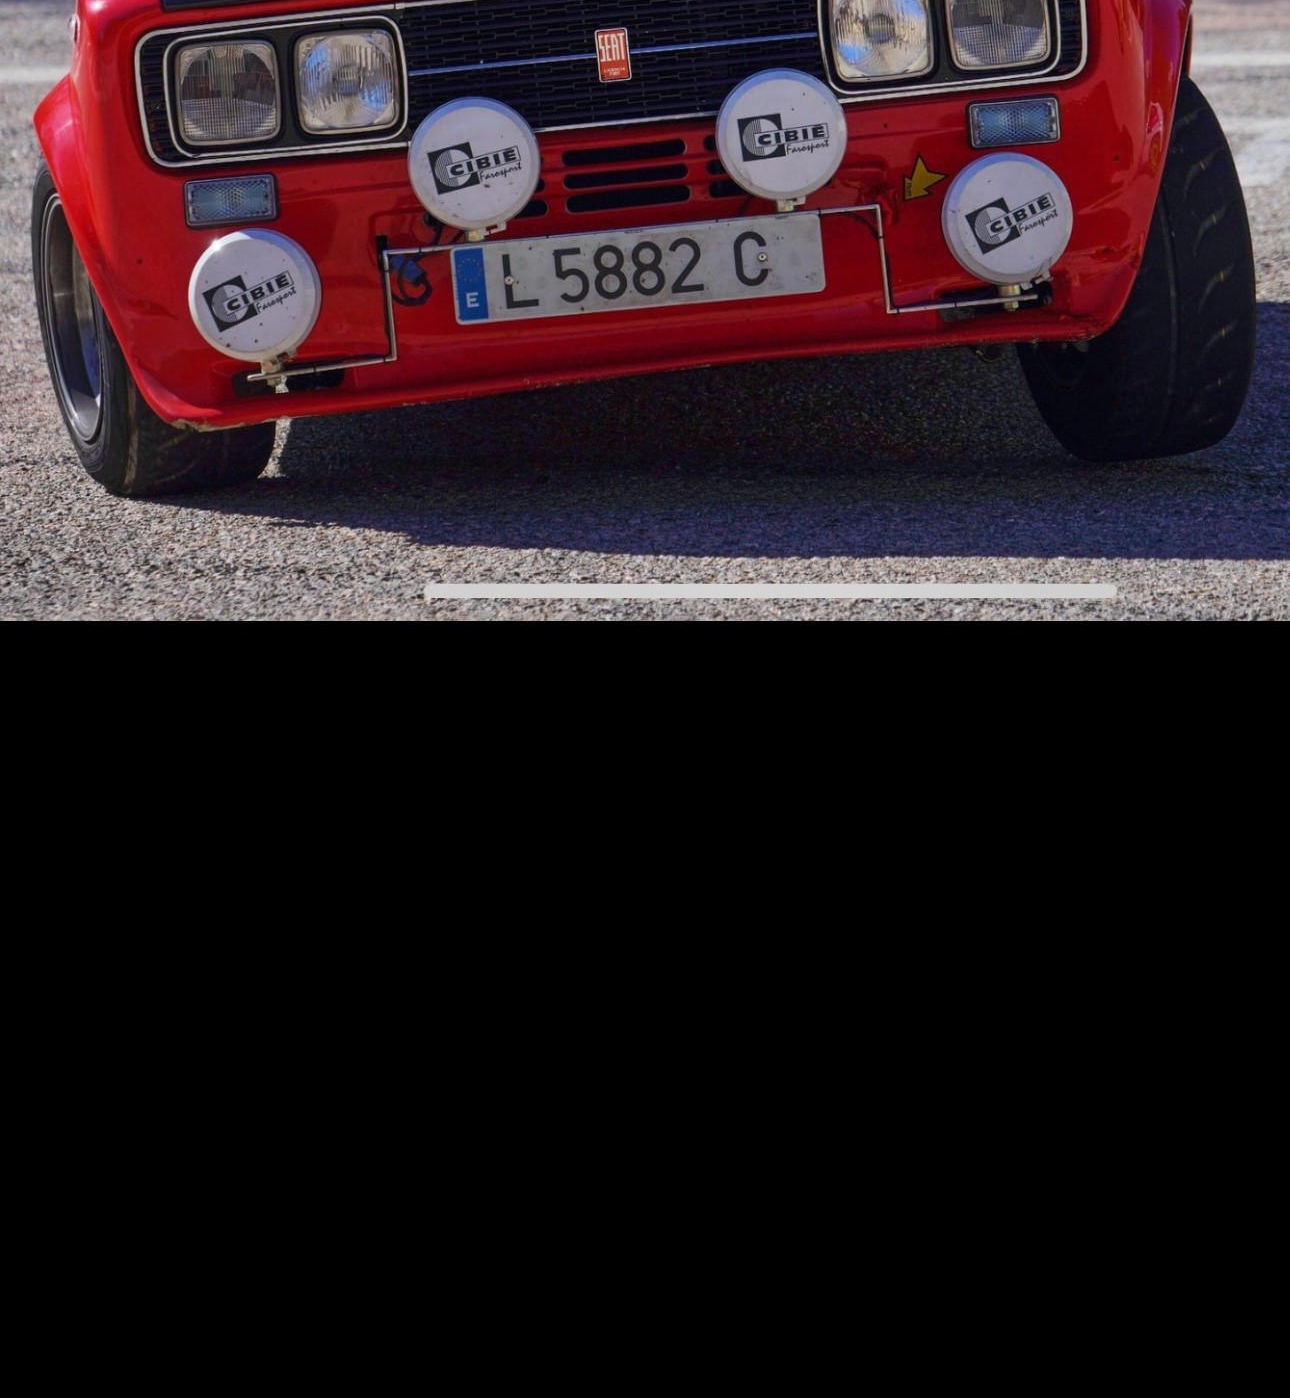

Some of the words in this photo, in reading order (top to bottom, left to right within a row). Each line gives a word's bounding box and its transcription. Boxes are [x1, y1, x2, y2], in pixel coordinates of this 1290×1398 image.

[598, 32, 626, 62] SEAT
[502, 253, 540, 309] L
[553, 237, 705, 303] 5882
[733, 231, 769, 287] C
[466, 292, 479, 308] E
